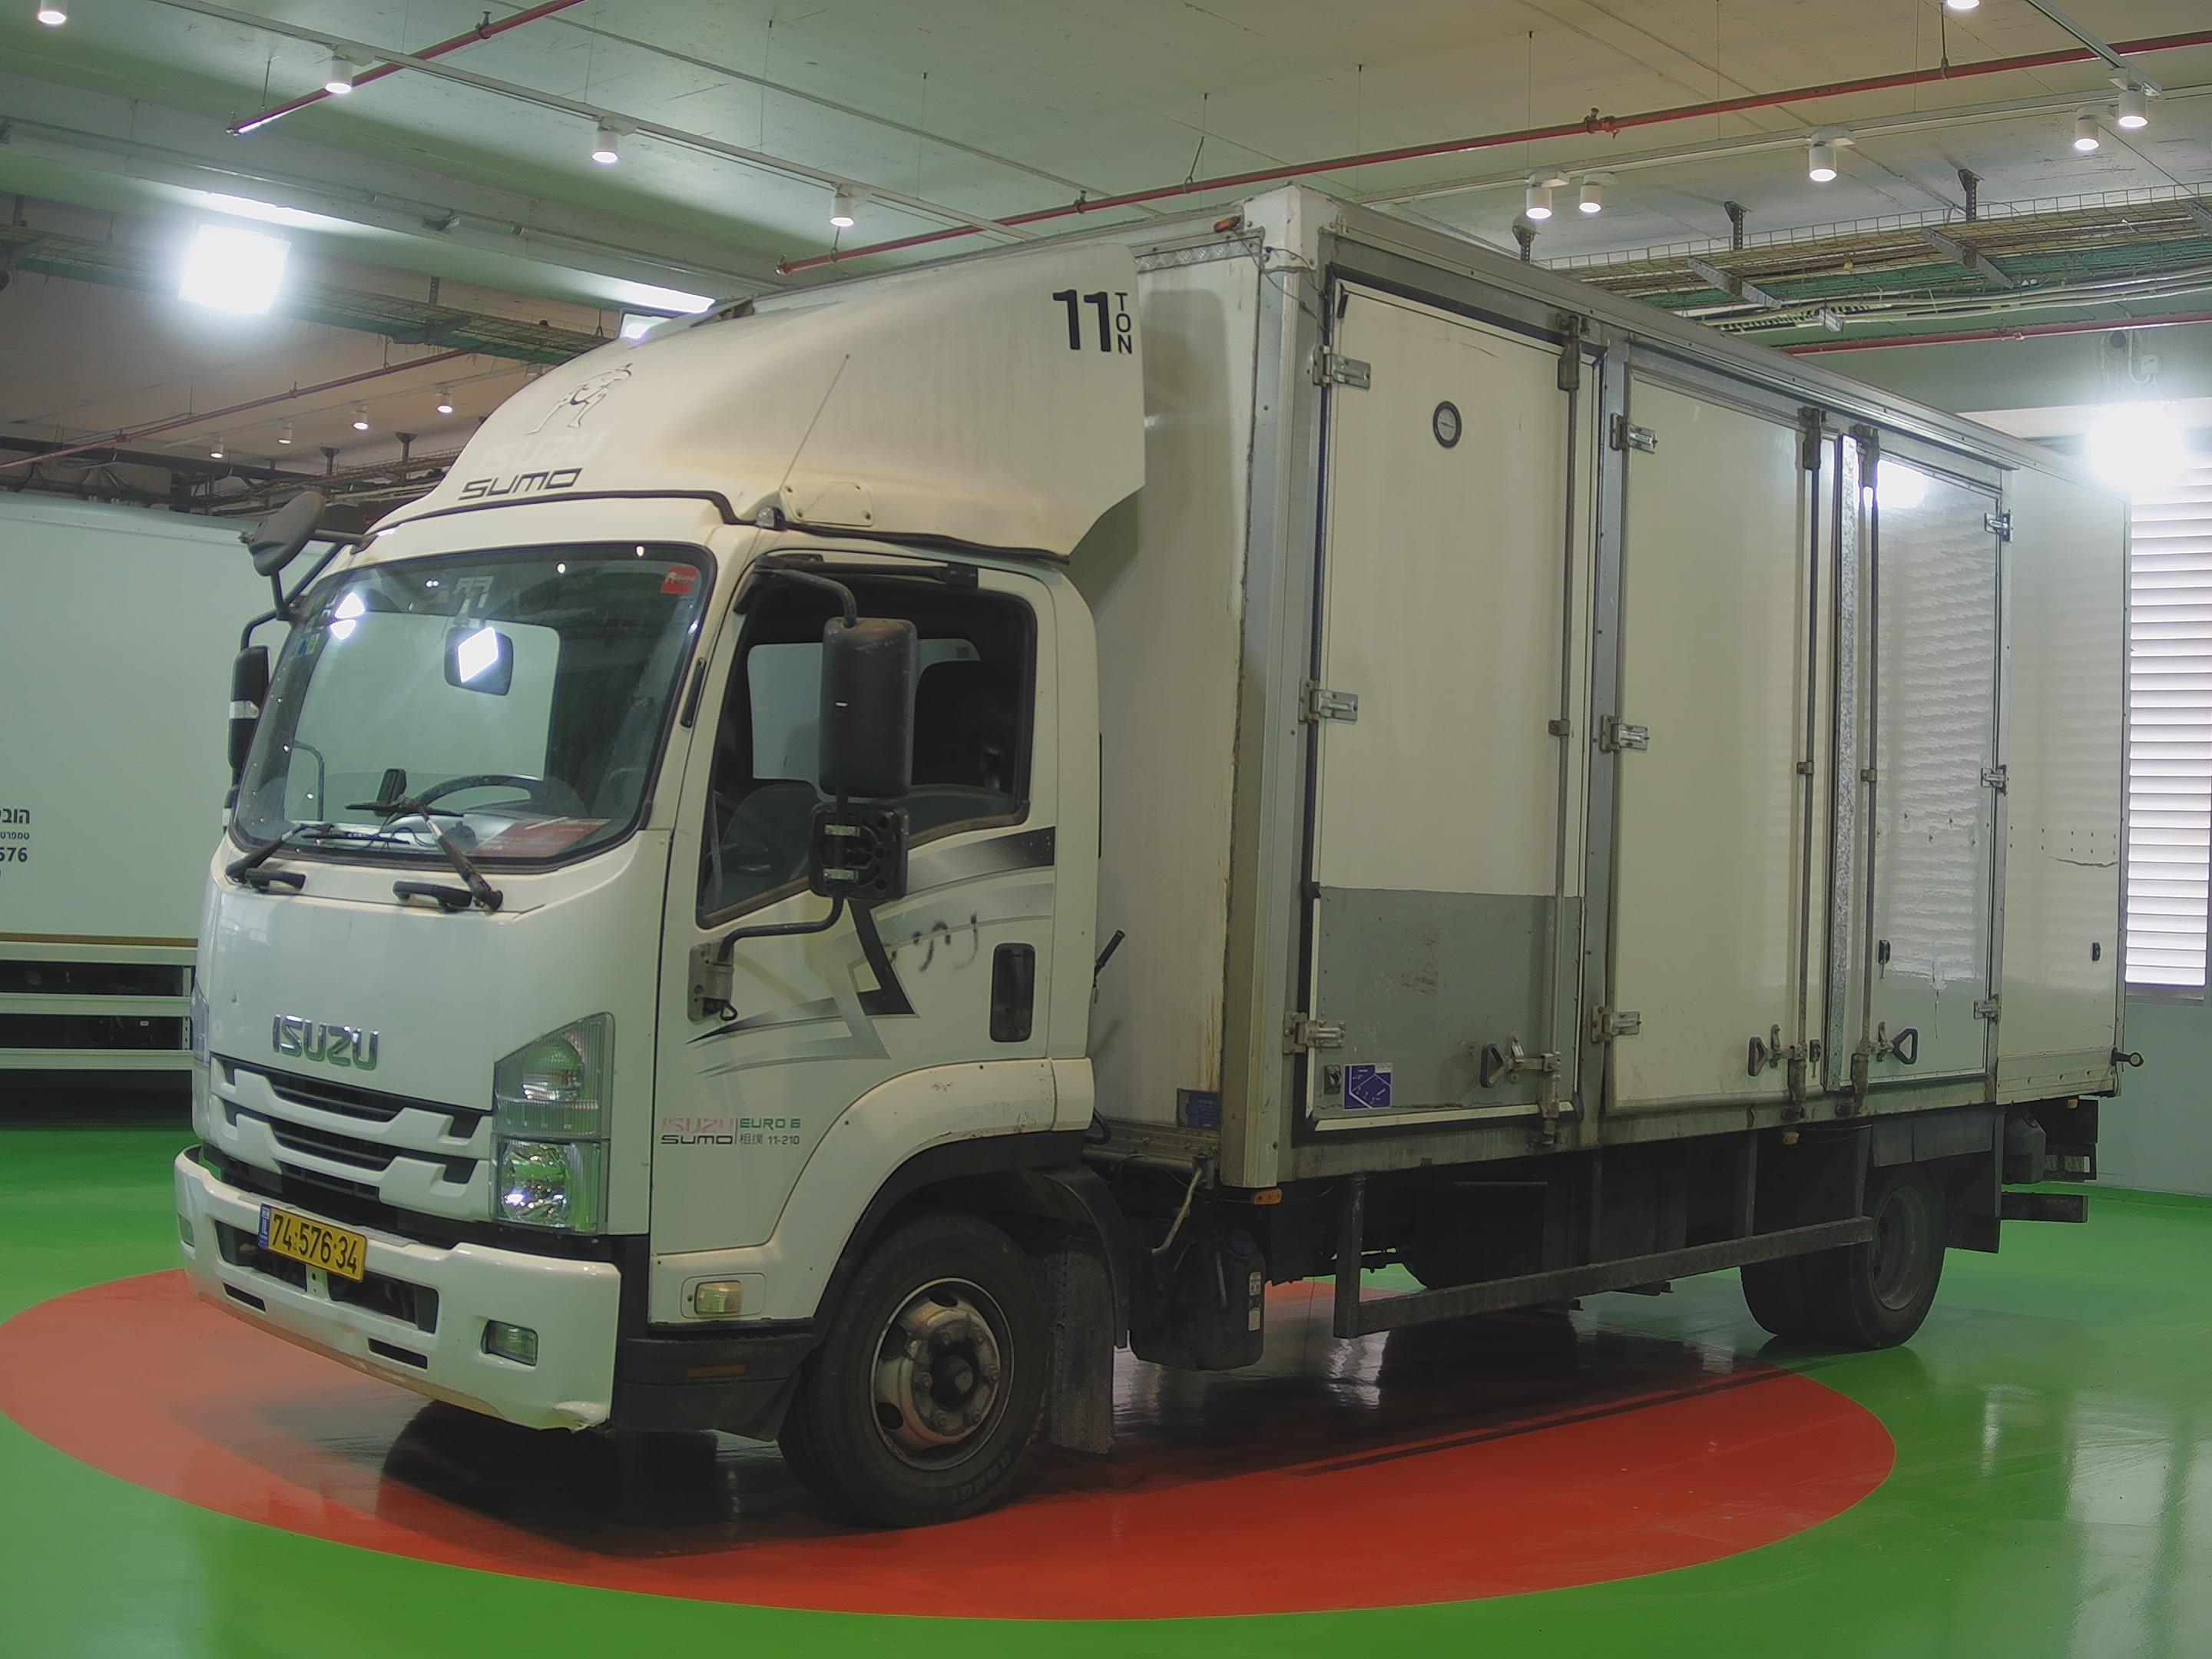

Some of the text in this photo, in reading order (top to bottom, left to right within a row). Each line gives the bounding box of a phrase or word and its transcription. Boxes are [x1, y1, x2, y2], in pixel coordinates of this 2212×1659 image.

[1053, 290, 1131, 354] 11 TON
[459, 468, 582, 500] SUMO
[0, 809, 30, 823] הוב
[273, 1014, 379, 1071] ISUZU
[740, 1118, 800, 1130] EURO 6
[661, 1134, 733, 1144] SUMO
